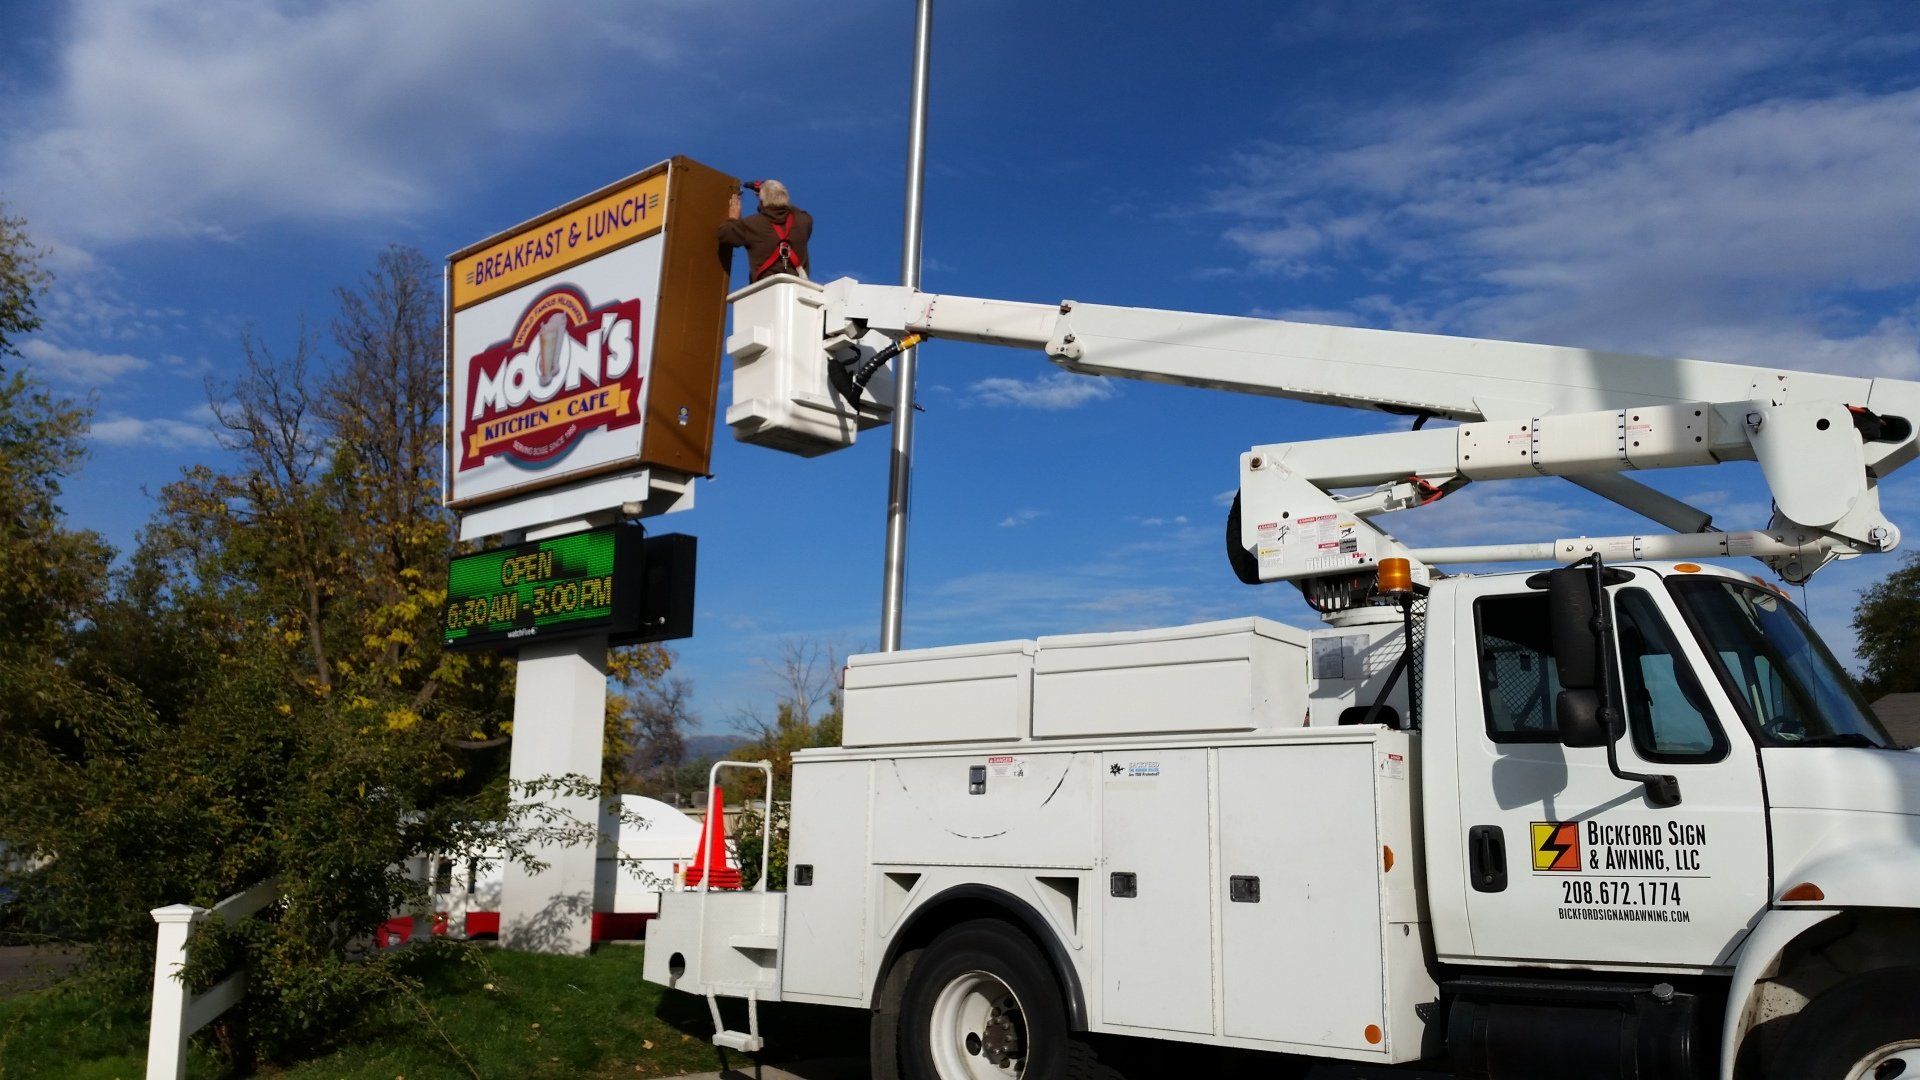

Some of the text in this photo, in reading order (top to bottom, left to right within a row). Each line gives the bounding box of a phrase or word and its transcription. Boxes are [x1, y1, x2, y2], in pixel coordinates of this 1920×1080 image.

[474, 193, 647, 286] BREAKFAST & LUNCH
[516, 316, 535, 344] WORLD
[534, 297, 556, 318] FAMOUS
[472, 312, 634, 421] MOON'S
[484, 408, 550, 441] KITCHEN
[502, 551, 552, 586] OPEN
[1587, 820, 1706, 846] BICKFORD SIGN
[1589, 846, 1701, 872] & AWNING, LLC
[1562, 880, 1681, 906] 208.672.1774
[1558, 907, 1690, 923] BICKFORDSIGNANDAWNING.COM
